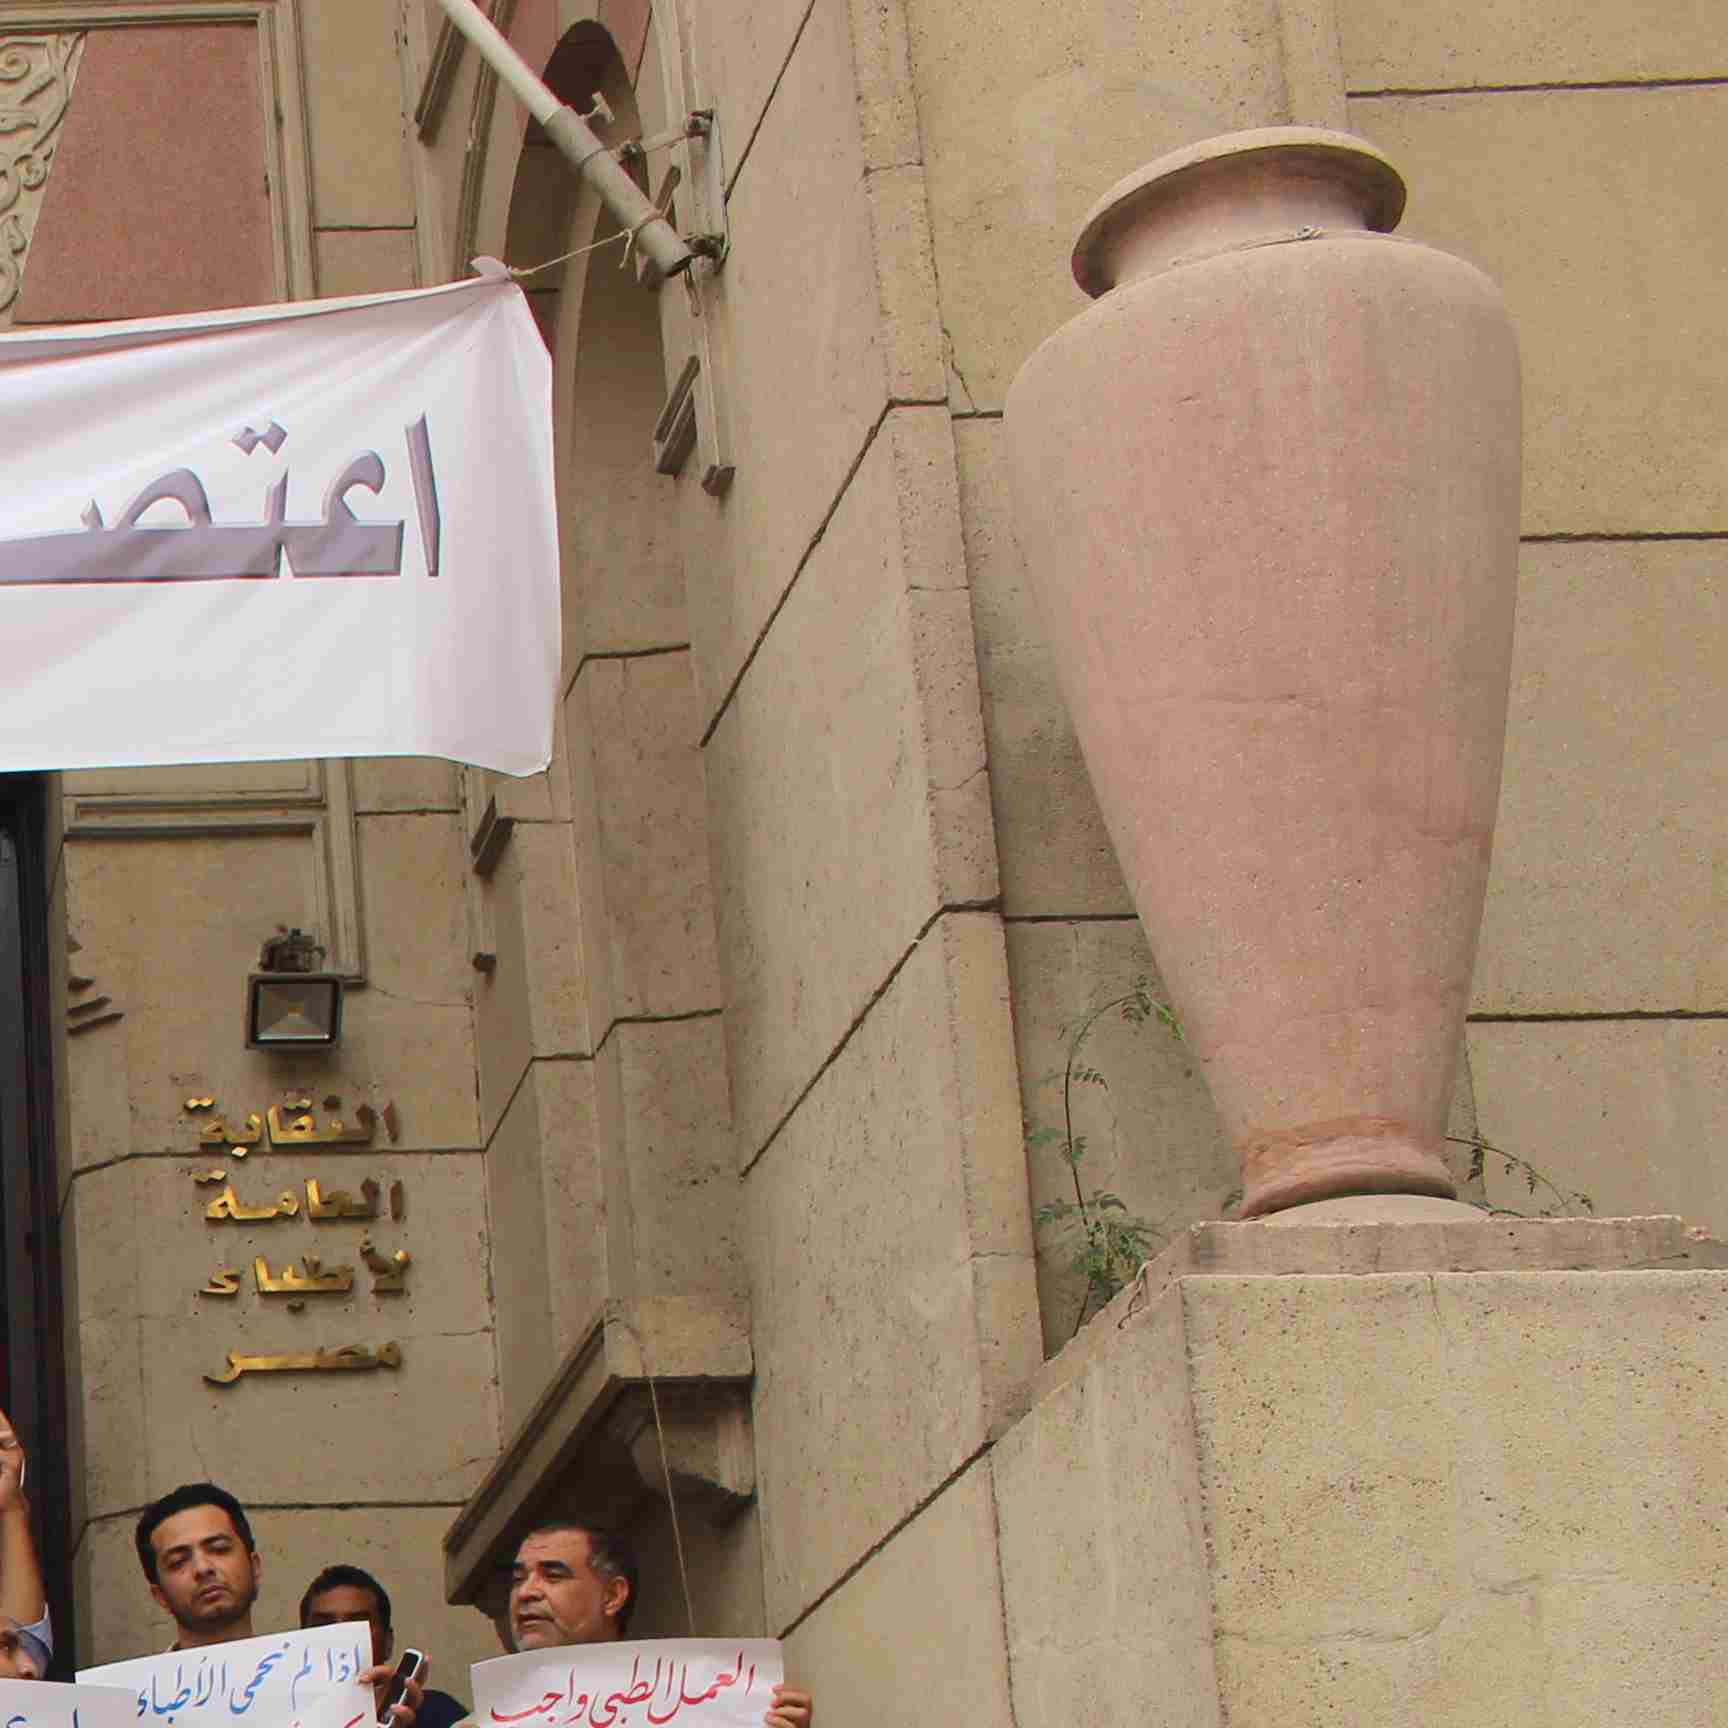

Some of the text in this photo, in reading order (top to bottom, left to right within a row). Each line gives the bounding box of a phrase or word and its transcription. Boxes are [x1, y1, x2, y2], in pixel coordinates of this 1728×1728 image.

[184, 1095, 398, 1158] النقابة
[191, 1169, 403, 1221] العامة
[202, 1342, 402, 1385] مصر
[647, 1650, 756, 1725] العمل
